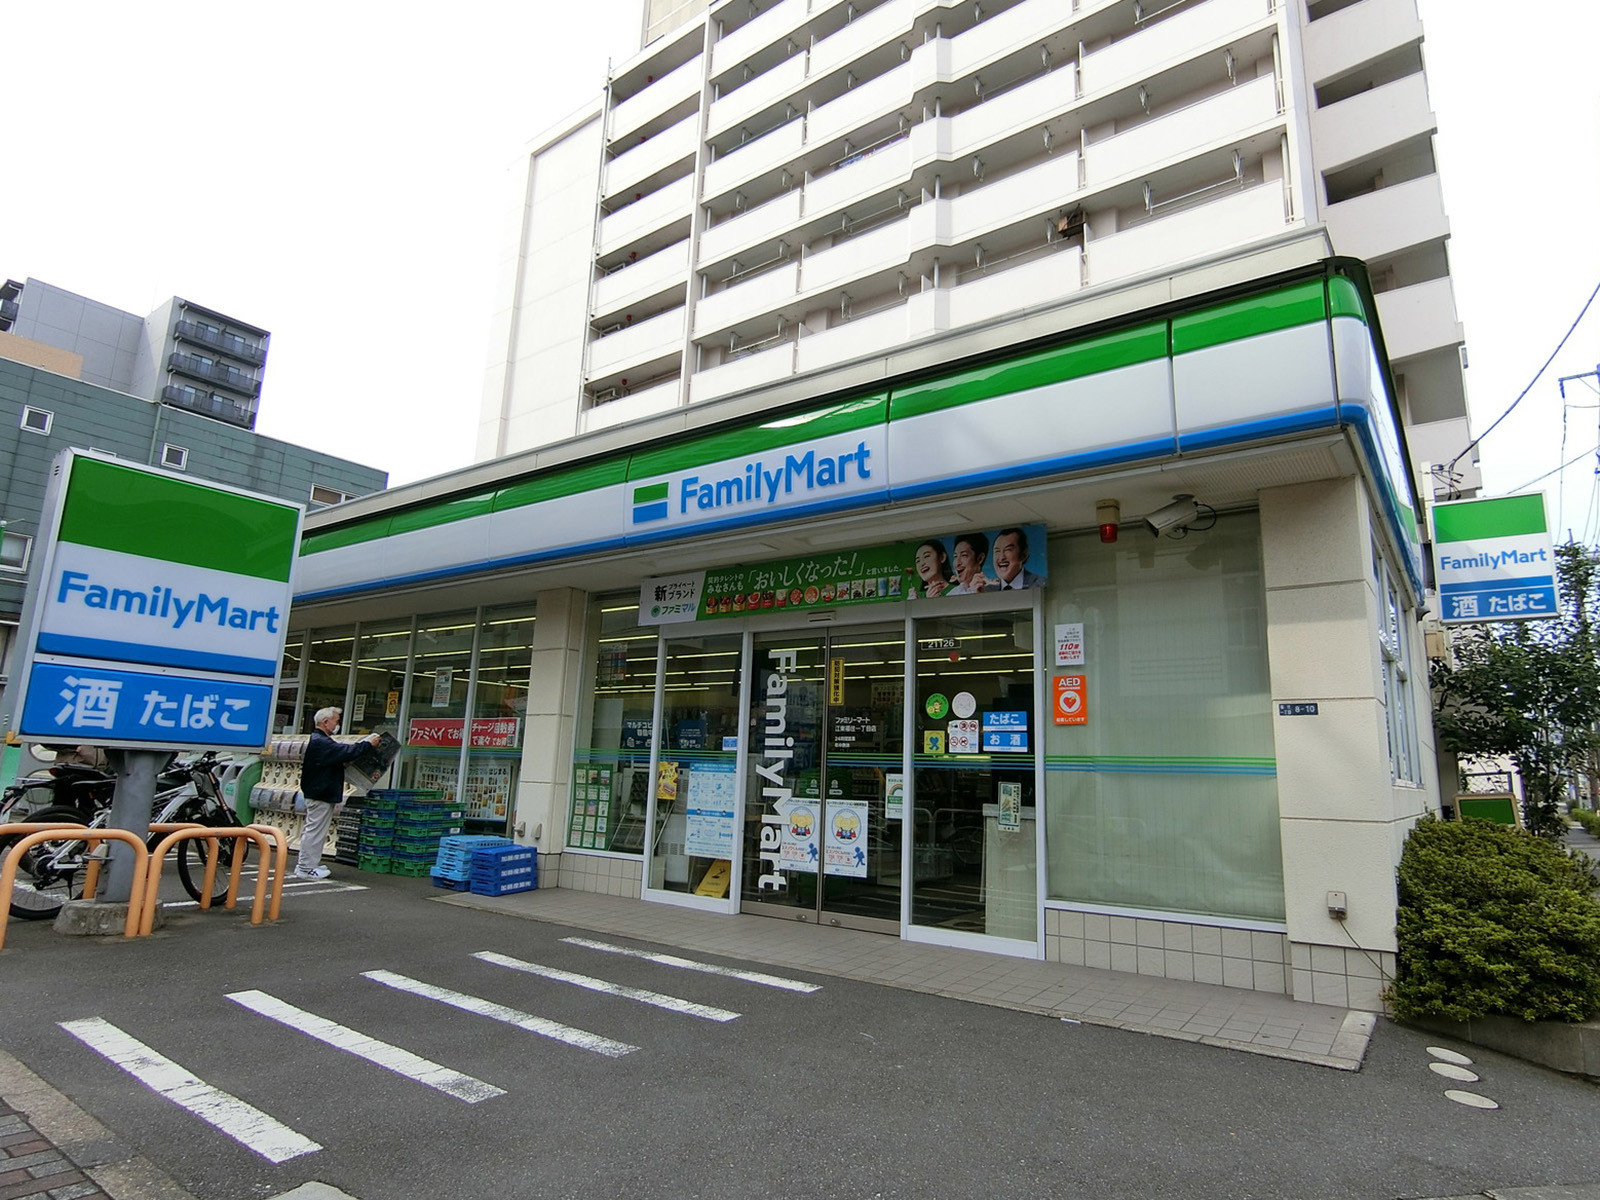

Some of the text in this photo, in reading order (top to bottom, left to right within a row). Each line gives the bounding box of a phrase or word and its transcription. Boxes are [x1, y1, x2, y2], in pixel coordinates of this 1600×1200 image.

[681, 441, 871, 513] FamilyMart
[1440, 547, 1548, 570] FamilyMart
[668, 581, 695, 590] プライベート
[707, 582, 744, 593] みなさんも
[654, 585, 667, 602] 新
[668, 588, 696, 600] ブランド
[57, 570, 279, 633] FamilyMart
[1452, 593, 1546, 617] 酒 たばこ
[662, 603, 696, 615] ファミマル
[928, 640, 954, 648] 21126
[1058, 678, 1081, 686] AED
[55, 676, 250, 732] 酒 たばこ
[1294, 705, 1316, 713] 8-10
[989, 713, 1020, 725] たばこ
[410, 726, 446, 741] ファミペイ
[755, 650, 797, 892] FamilyMart
